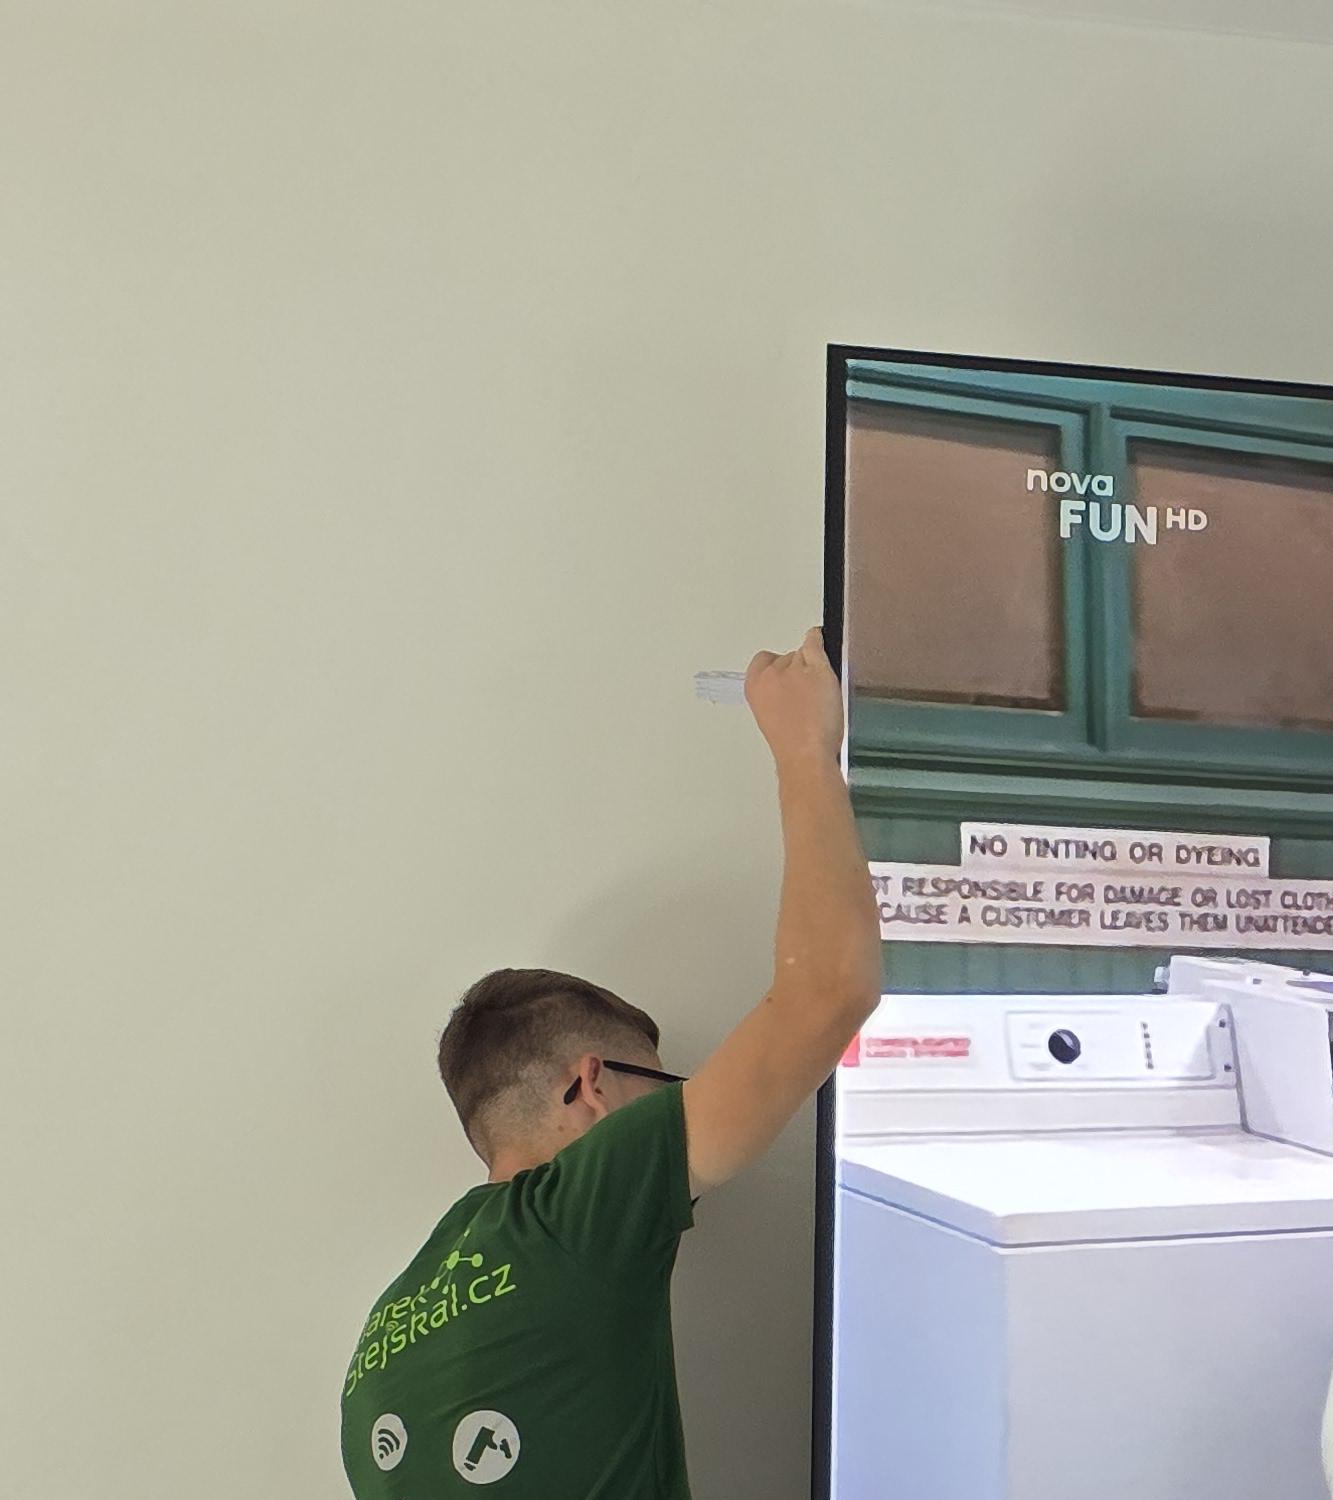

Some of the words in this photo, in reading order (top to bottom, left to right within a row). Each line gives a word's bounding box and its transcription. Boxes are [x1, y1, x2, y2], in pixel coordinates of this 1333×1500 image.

[1026, 468, 1114, 497] nova
[1059, 500, 1158, 545] FUN
[1166, 507, 1208, 531] HD
[969, 834, 1007, 858] NO
[1129, 840, 1163, 865] OR
[1175, 843, 1261, 868] DYEING
[1055, 881, 1095, 902] FOR
[1190, 885, 1218, 908] OR
[1225, 887, 1272, 910] LOST
[957, 904, 972, 924] A
[980, 904, 1092, 929] CUSTOMER
[360, 1284, 427, 1343] arek
